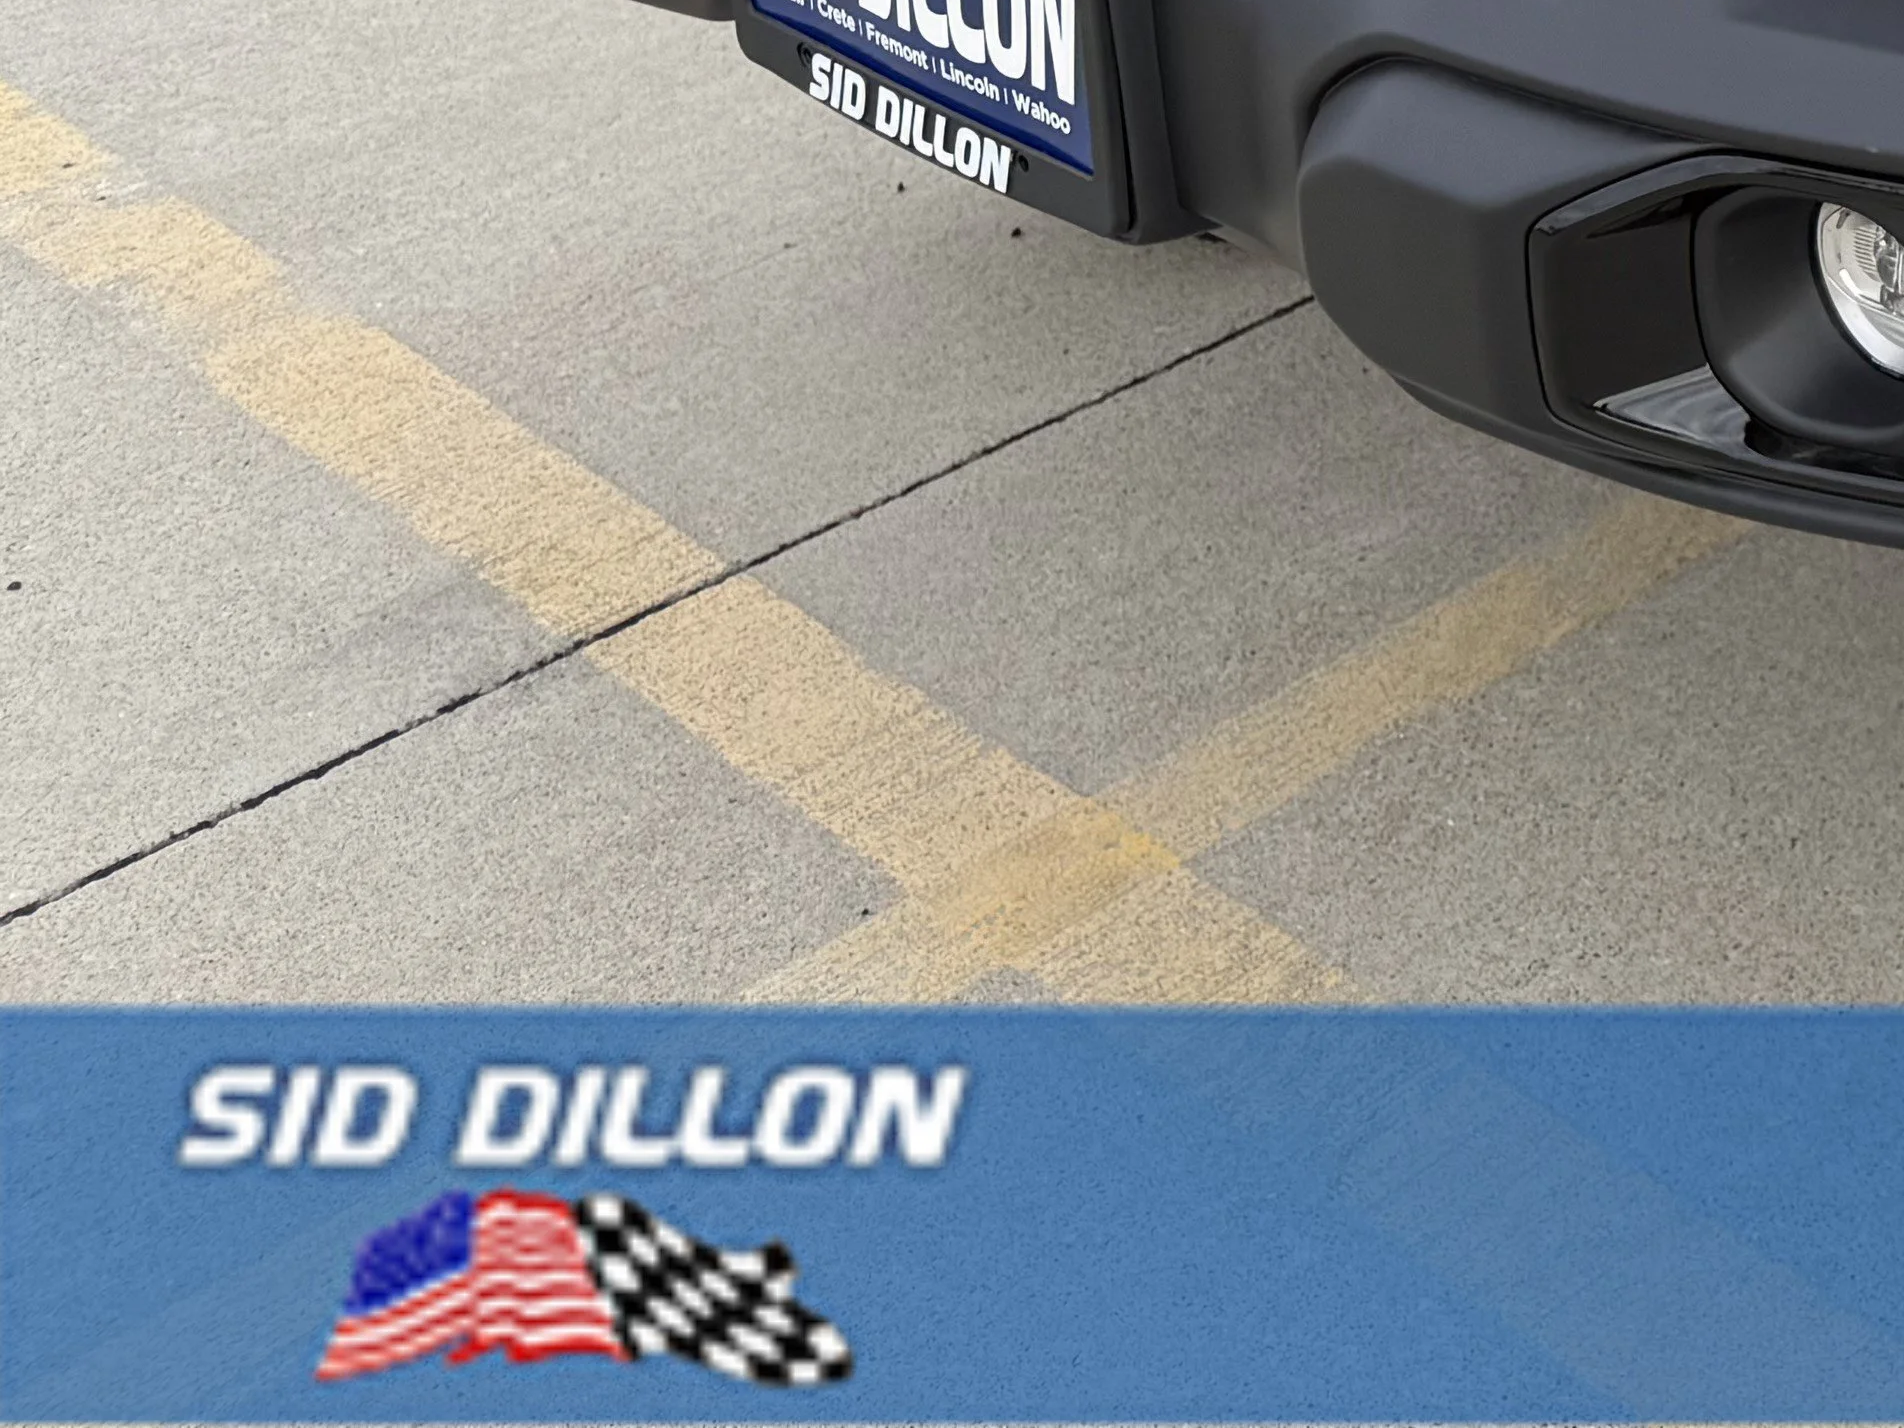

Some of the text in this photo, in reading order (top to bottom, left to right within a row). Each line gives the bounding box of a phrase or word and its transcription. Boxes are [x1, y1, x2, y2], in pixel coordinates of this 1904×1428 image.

[809, 53, 1012, 193] SID DILLON
[866, 26, 929, 71] Fremont
[940, 59, 1000, 102] Lincoln
[1011, 89, 1071, 135] Wahoo
